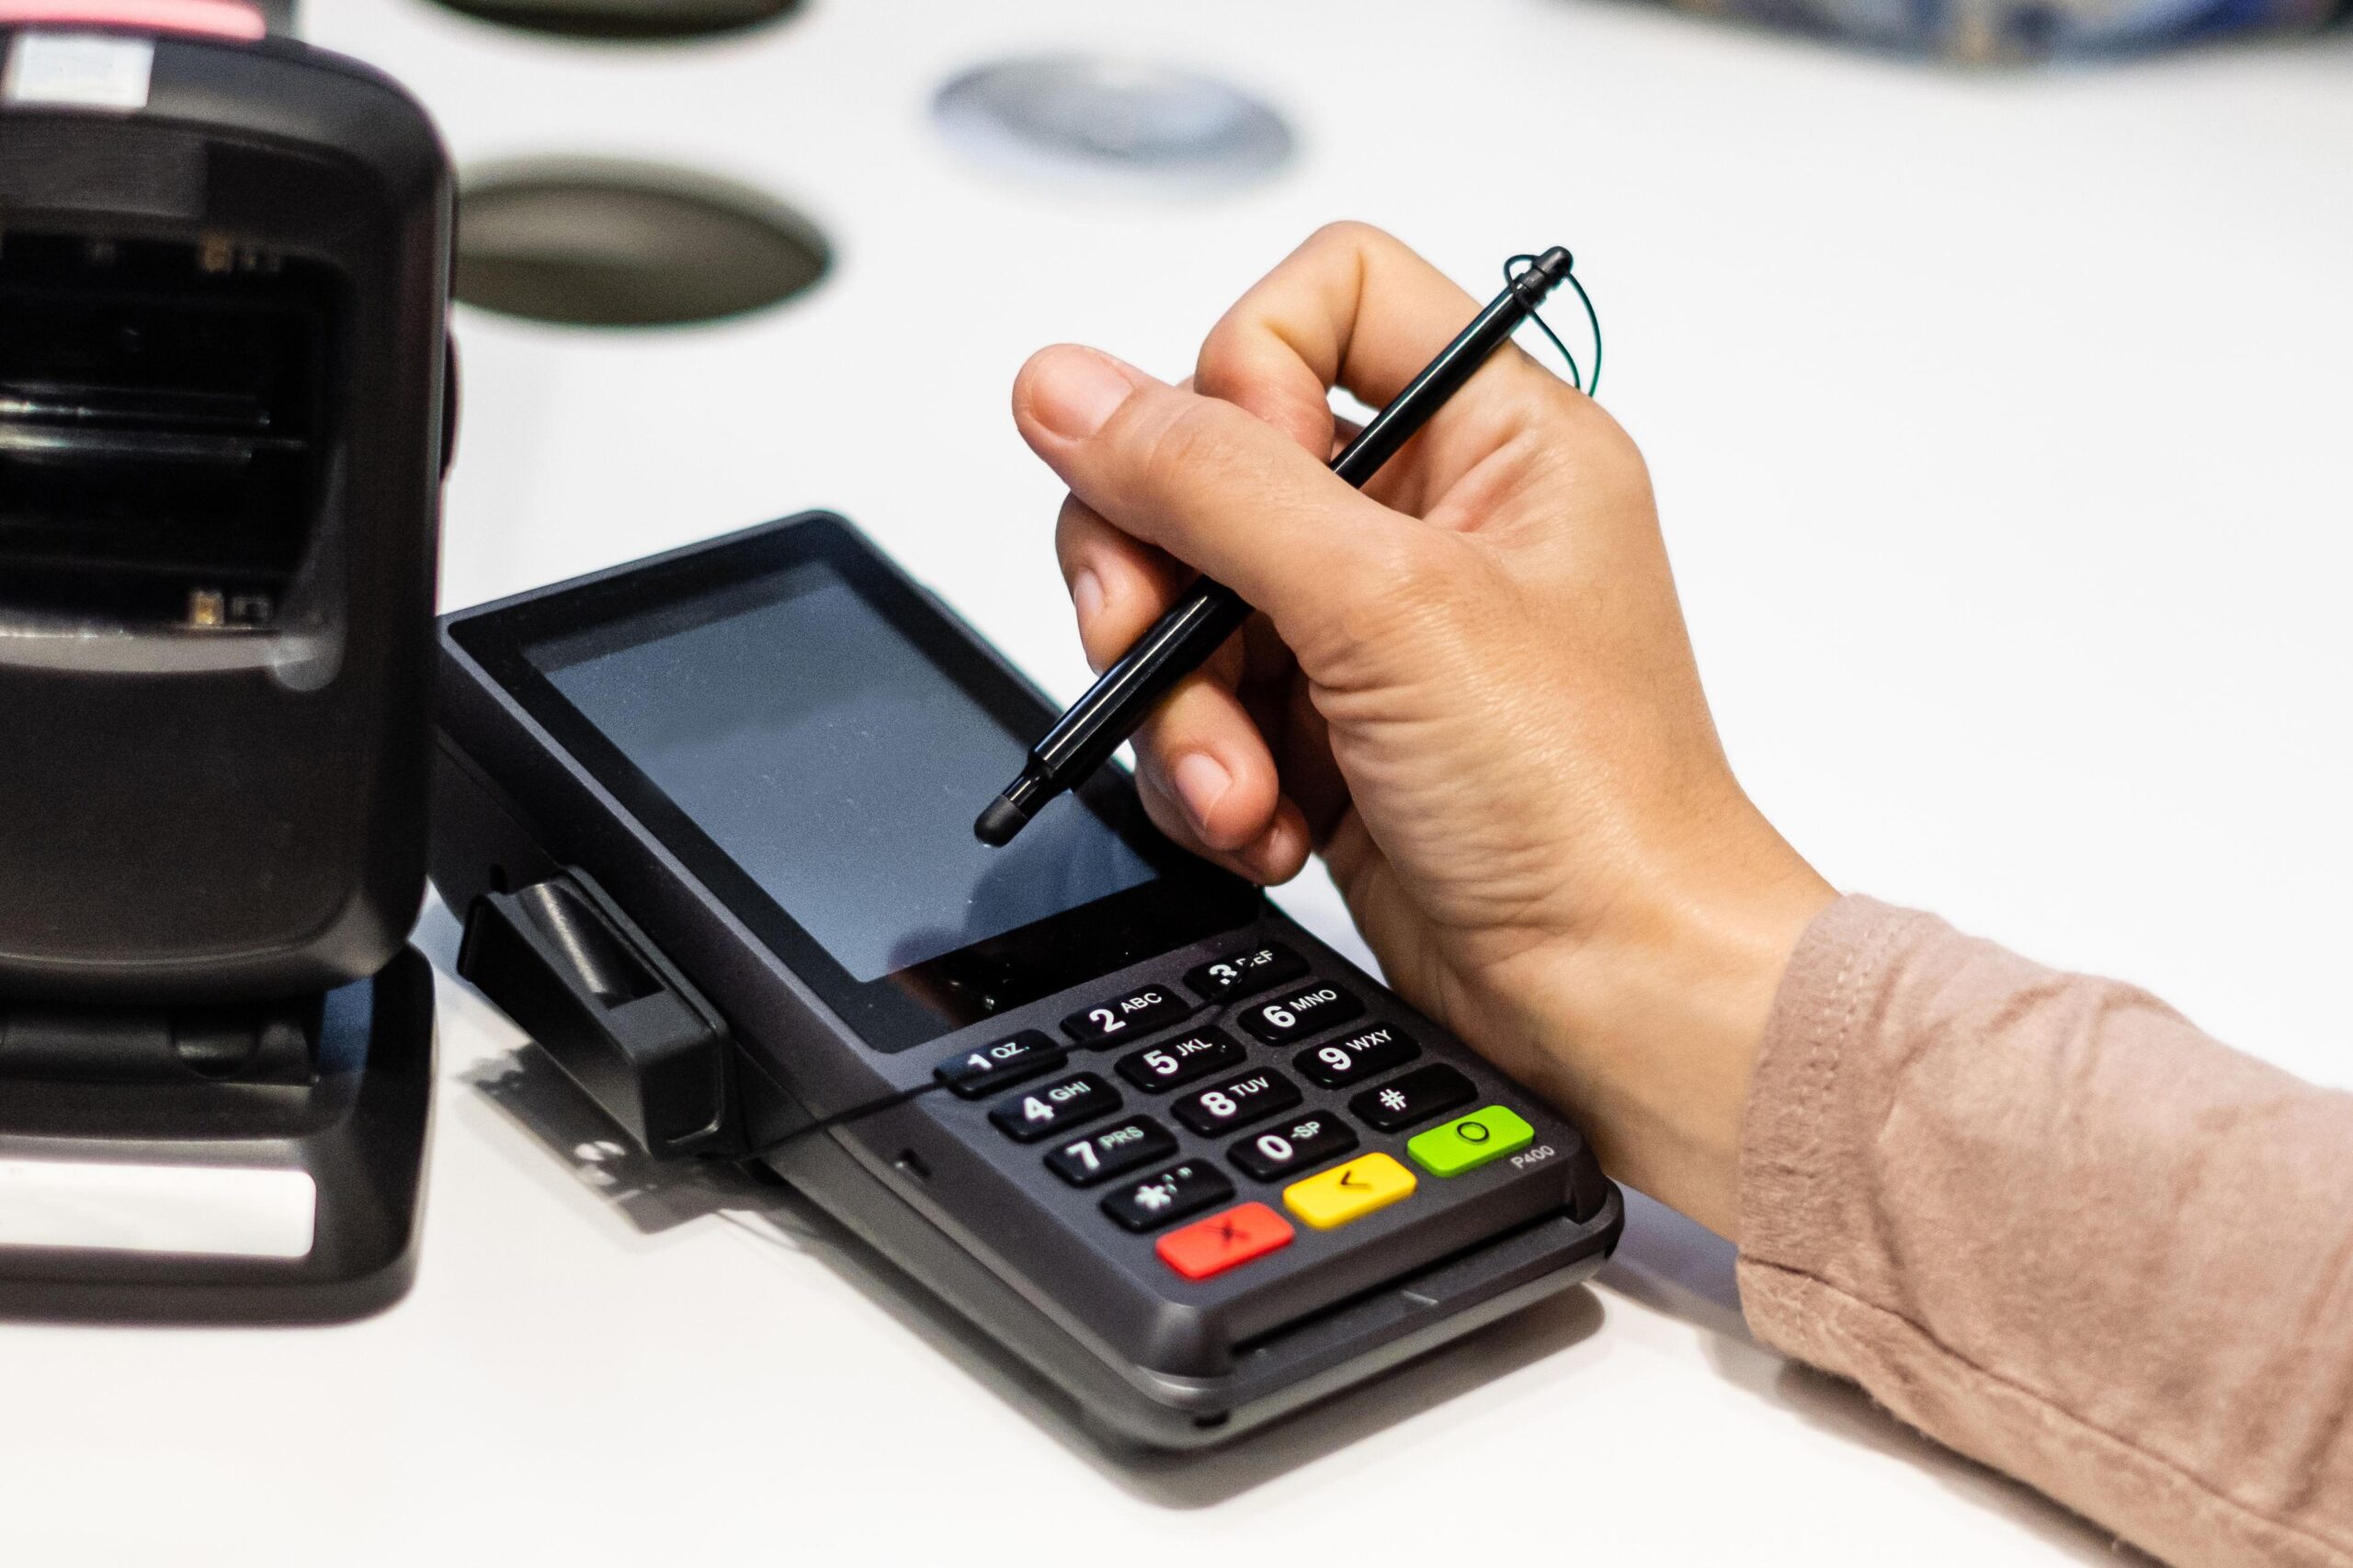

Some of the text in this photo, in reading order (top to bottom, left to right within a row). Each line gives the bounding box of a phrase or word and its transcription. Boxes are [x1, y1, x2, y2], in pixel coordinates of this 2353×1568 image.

[1088, 992, 1163, 1033] 2 ABC
[1262, 989, 1337, 1028] 6 MNO
[967, 1053, 993, 1071] 1
[1142, 1038, 1213, 1074] 5 JKL
[1318, 1029, 1392, 1071] 9 WXY
[1022, 1081, 1092, 1121] 4 GHI
[1200, 1076, 1269, 1117] 8 TUV
[1380, 1088, 1406, 1112] #
[1066, 1126, 1144, 1170] 7 PRS
[1256, 1135, 1293, 1161] 0
[1510, 1144, 1555, 1170] P400
